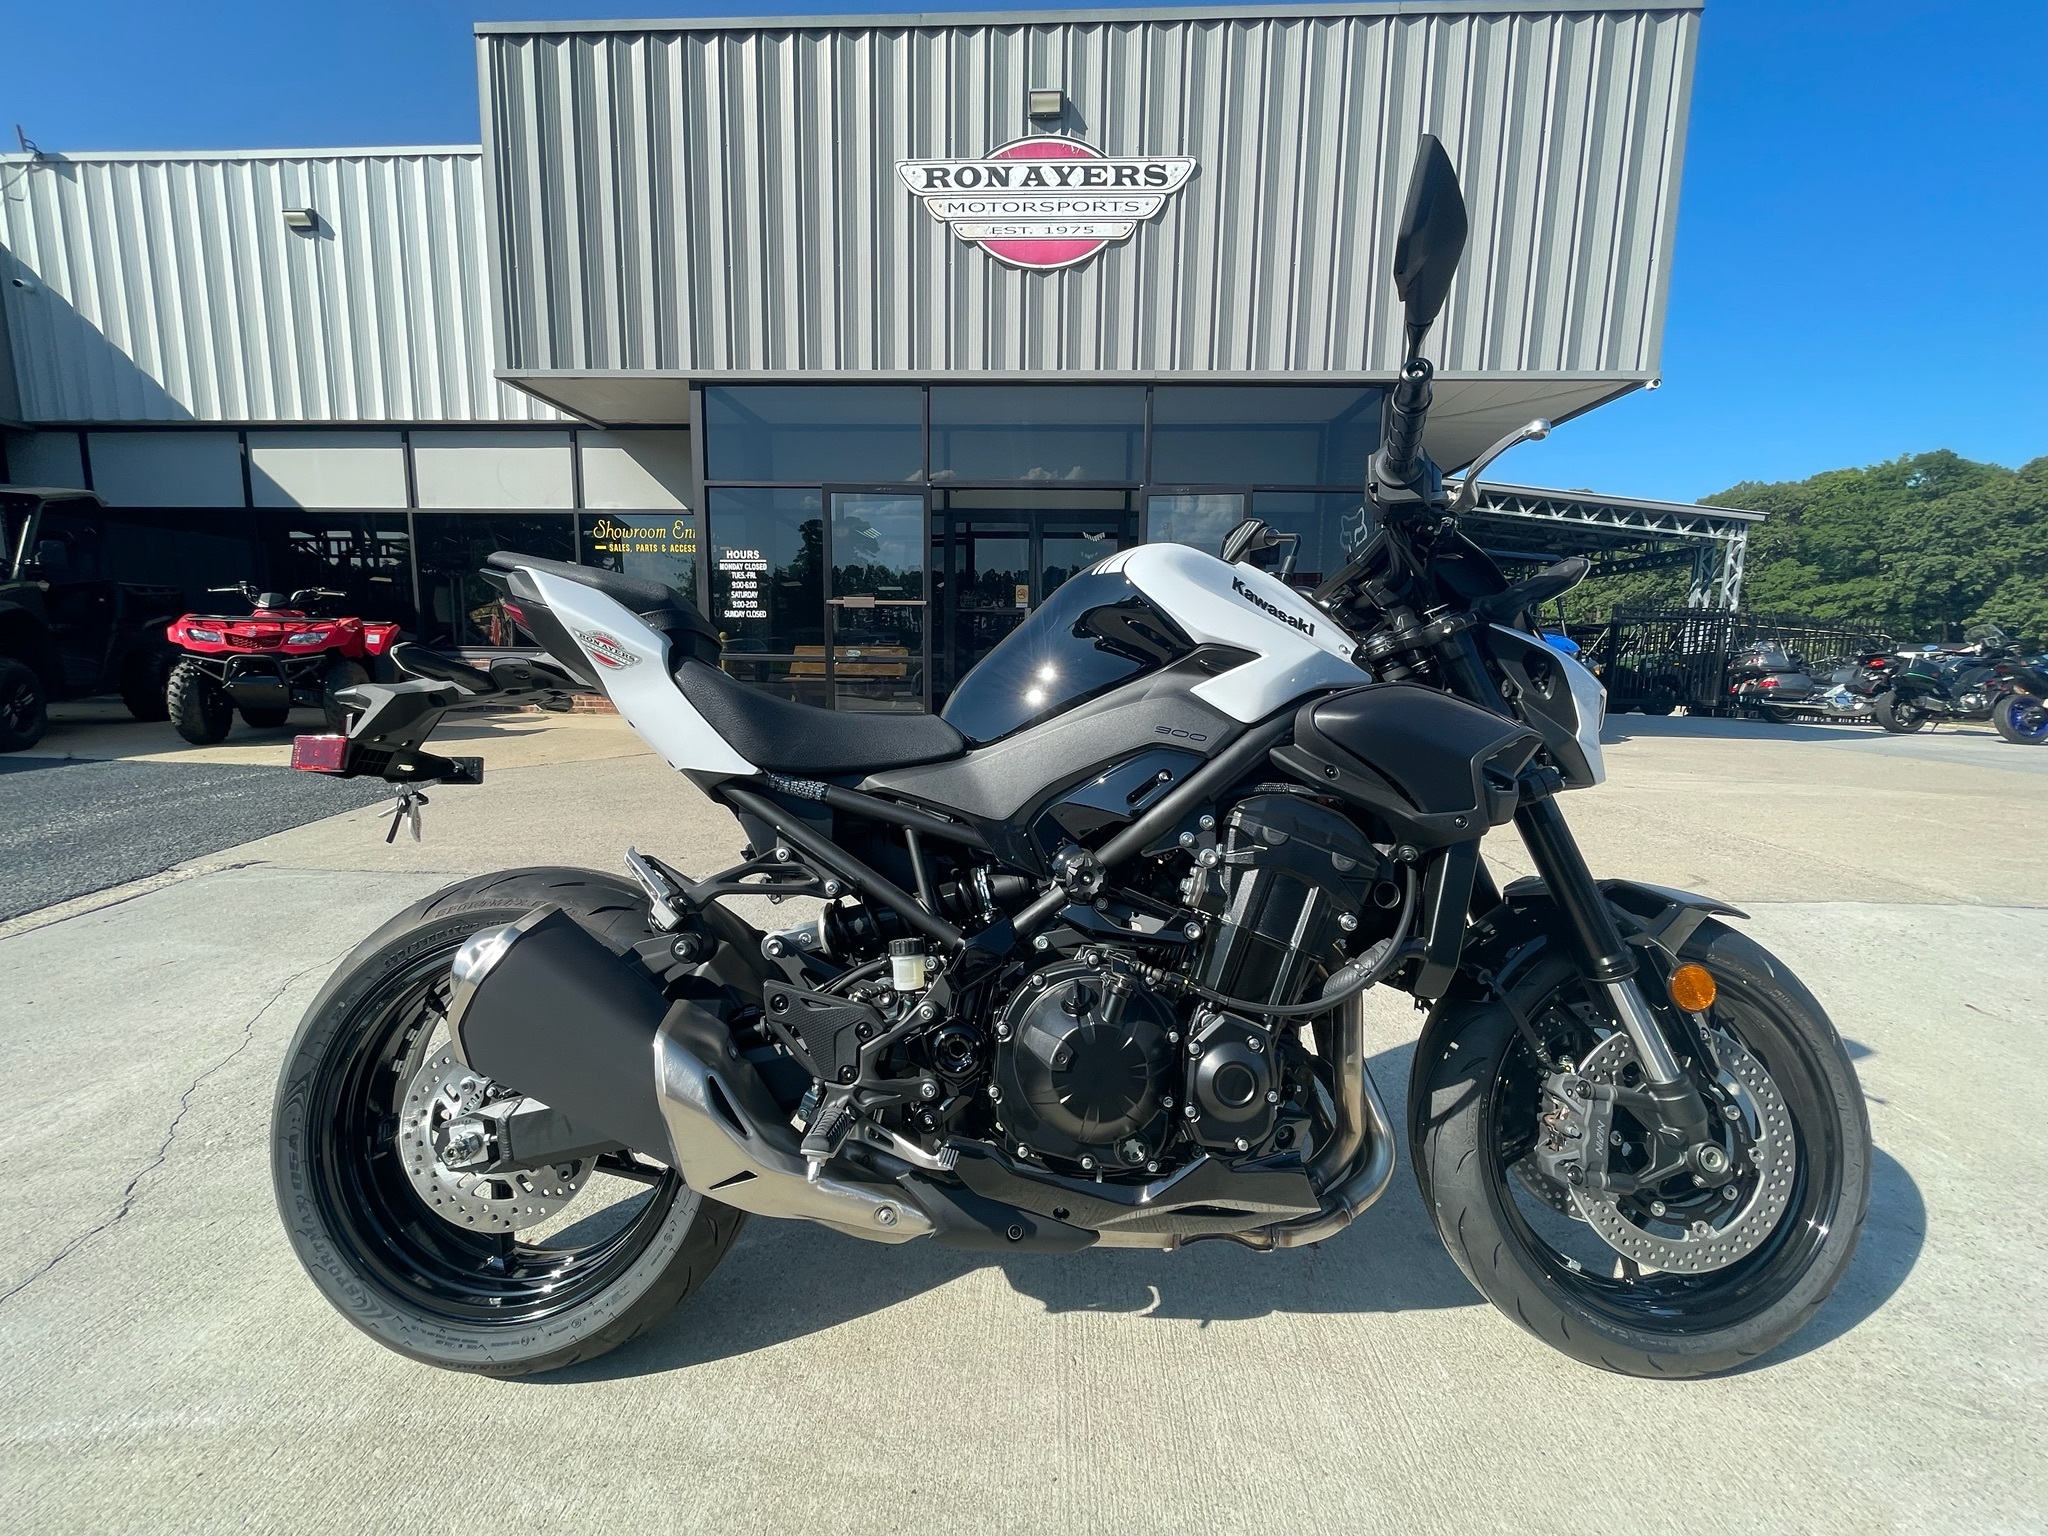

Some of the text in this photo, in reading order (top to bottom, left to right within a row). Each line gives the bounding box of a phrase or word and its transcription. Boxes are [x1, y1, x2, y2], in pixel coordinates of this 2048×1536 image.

[922, 165, 1168, 188] RON AYERS
[948, 201, 1139, 213] MOTORSPORTS
[992, 226, 1094, 235] EST. 1975
[593, 520, 666, 540] Showroom
[609, 543, 632, 553] SALES,
[635, 543, 658, 552] PARTS
[726, 550, 760, 559] HOURS
[731, 581, 757, 589] 9:00-6:00
[731, 591, 758, 599] SATURDAY
[1232, 576, 1315, 637] Kawasaki
[724, 610, 767, 618] SUNDAY CLOSED
[1154, 725, 1207, 742] 900
